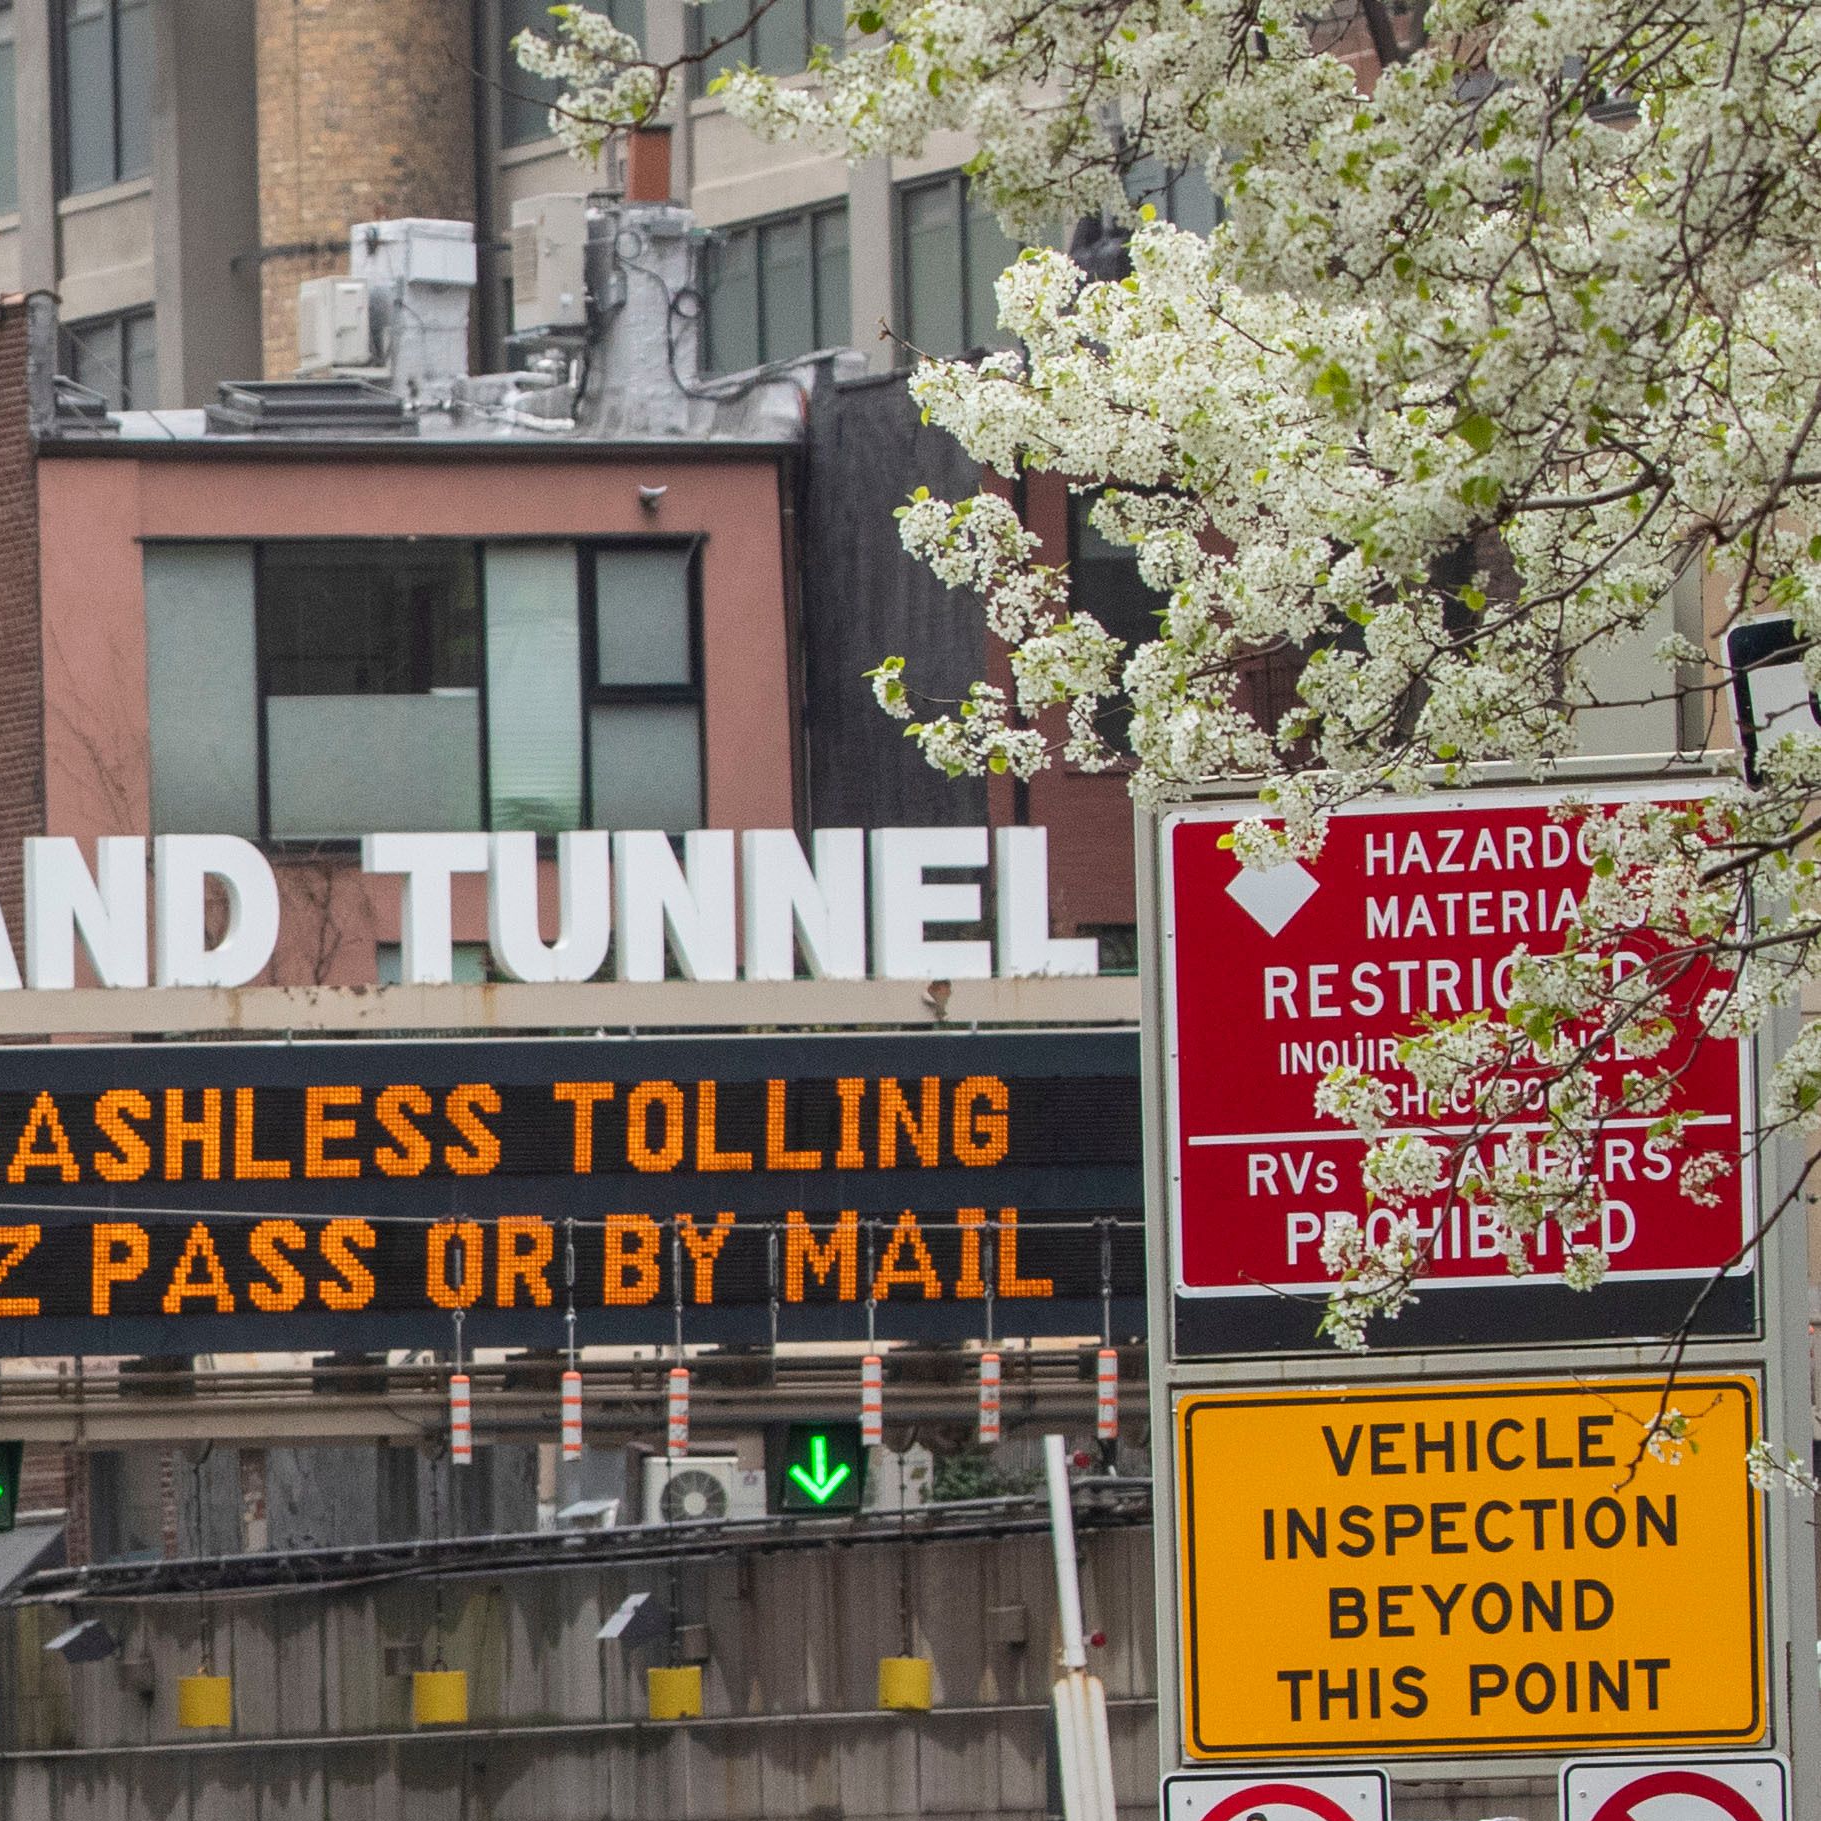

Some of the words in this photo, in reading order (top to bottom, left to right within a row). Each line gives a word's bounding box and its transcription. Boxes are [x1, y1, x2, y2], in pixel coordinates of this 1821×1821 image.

[363, 826, 1099, 984] TUNNEL
[553, 1075, 1009, 1174] TOLLING
[1248, 1151, 1338, 1197] RVs
[92, 1218, 376, 1315] PASS
[425, 1215, 554, 1308] OR
[604, 1212, 735, 1305] BY
[785, 1207, 1054, 1302] MAIL
[1322, 1414, 1616, 1477] VEHICLE
[1263, 1494, 1679, 1561] INSPECTION
[1329, 1579, 1614, 1639] BEYOND
[1277, 1666, 1429, 1722] THIS
[1470, 1658, 1671, 1716] POINT
